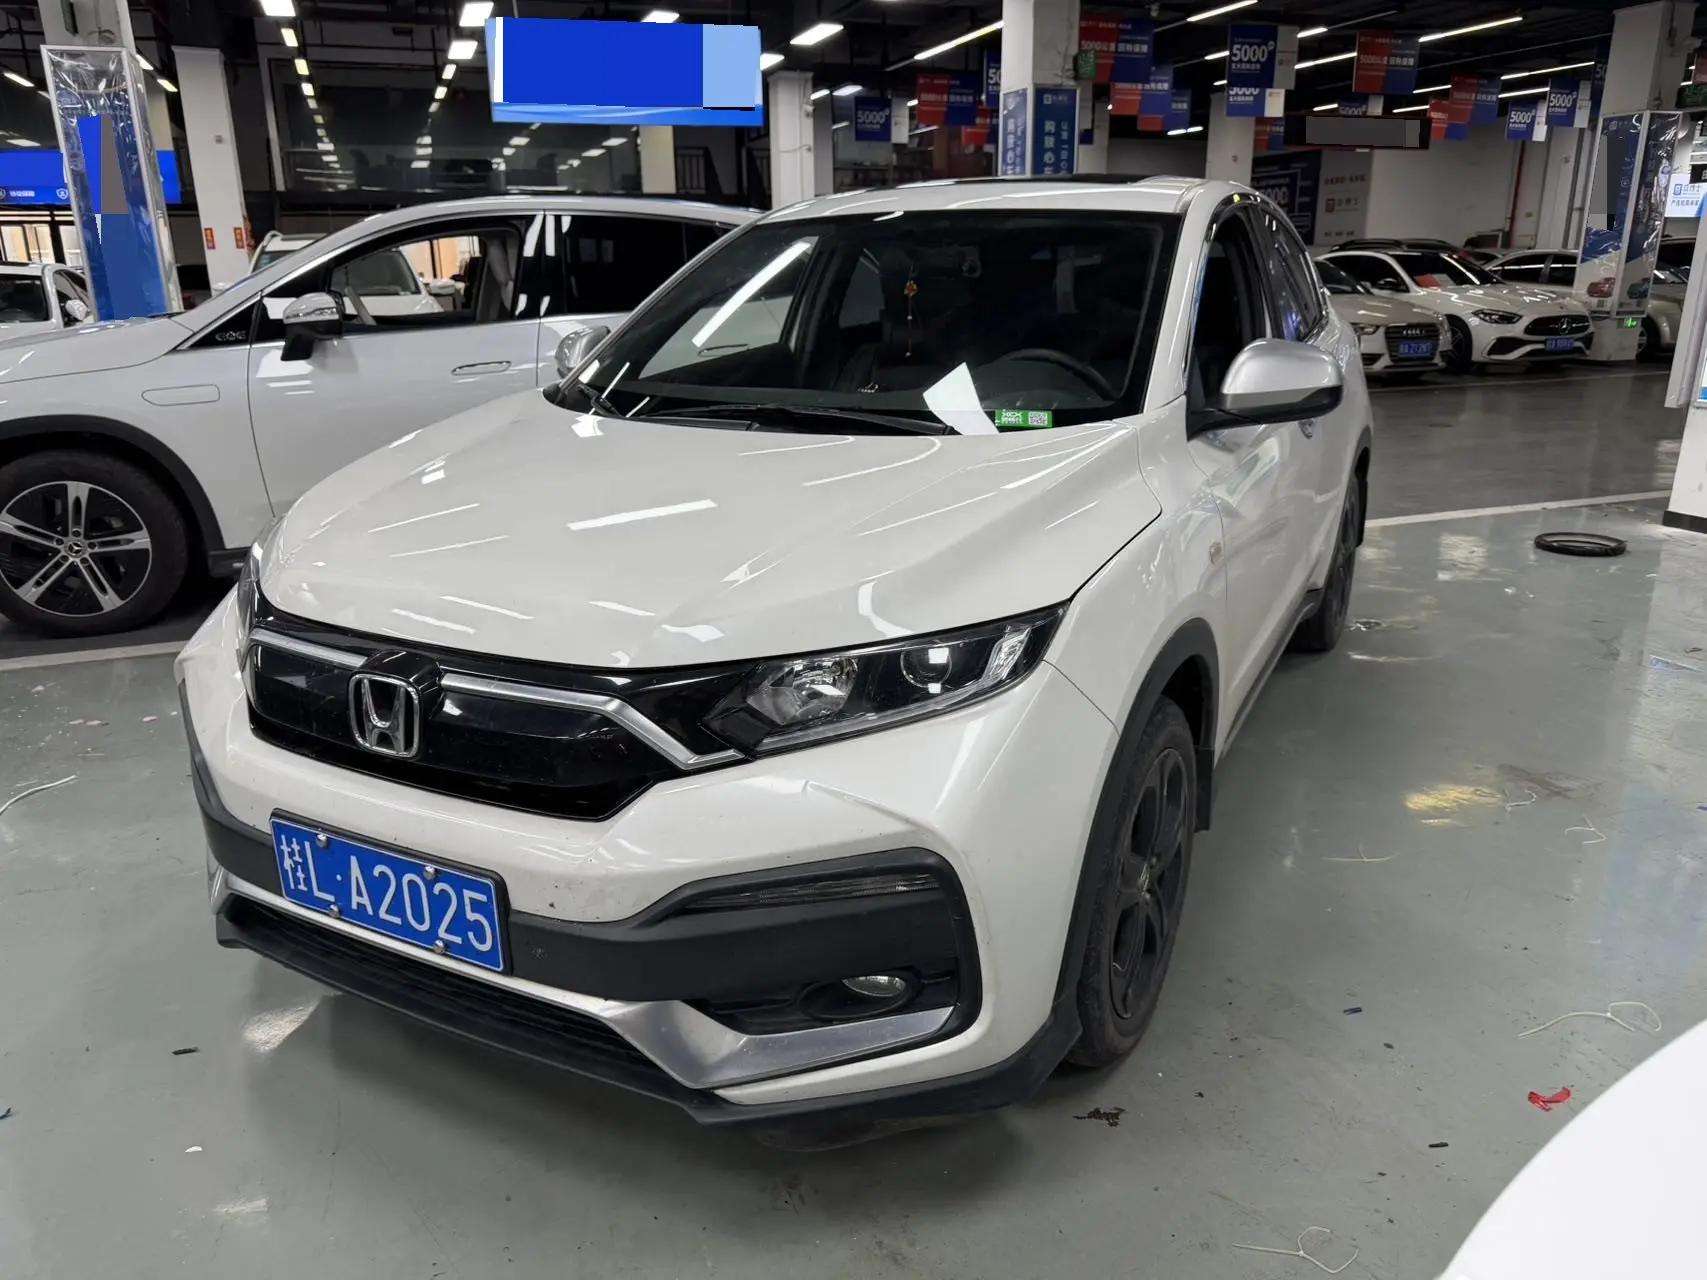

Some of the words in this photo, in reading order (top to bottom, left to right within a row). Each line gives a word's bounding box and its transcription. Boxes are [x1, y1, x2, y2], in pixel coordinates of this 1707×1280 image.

[1231, 44, 1268, 62] 5000
[1549, 93, 1573, 107] 5000
[857, 110, 886, 124] 5000
[1509, 110, 1532, 123] 5000
[280, 834, 493, 952] 桂L·A2025
